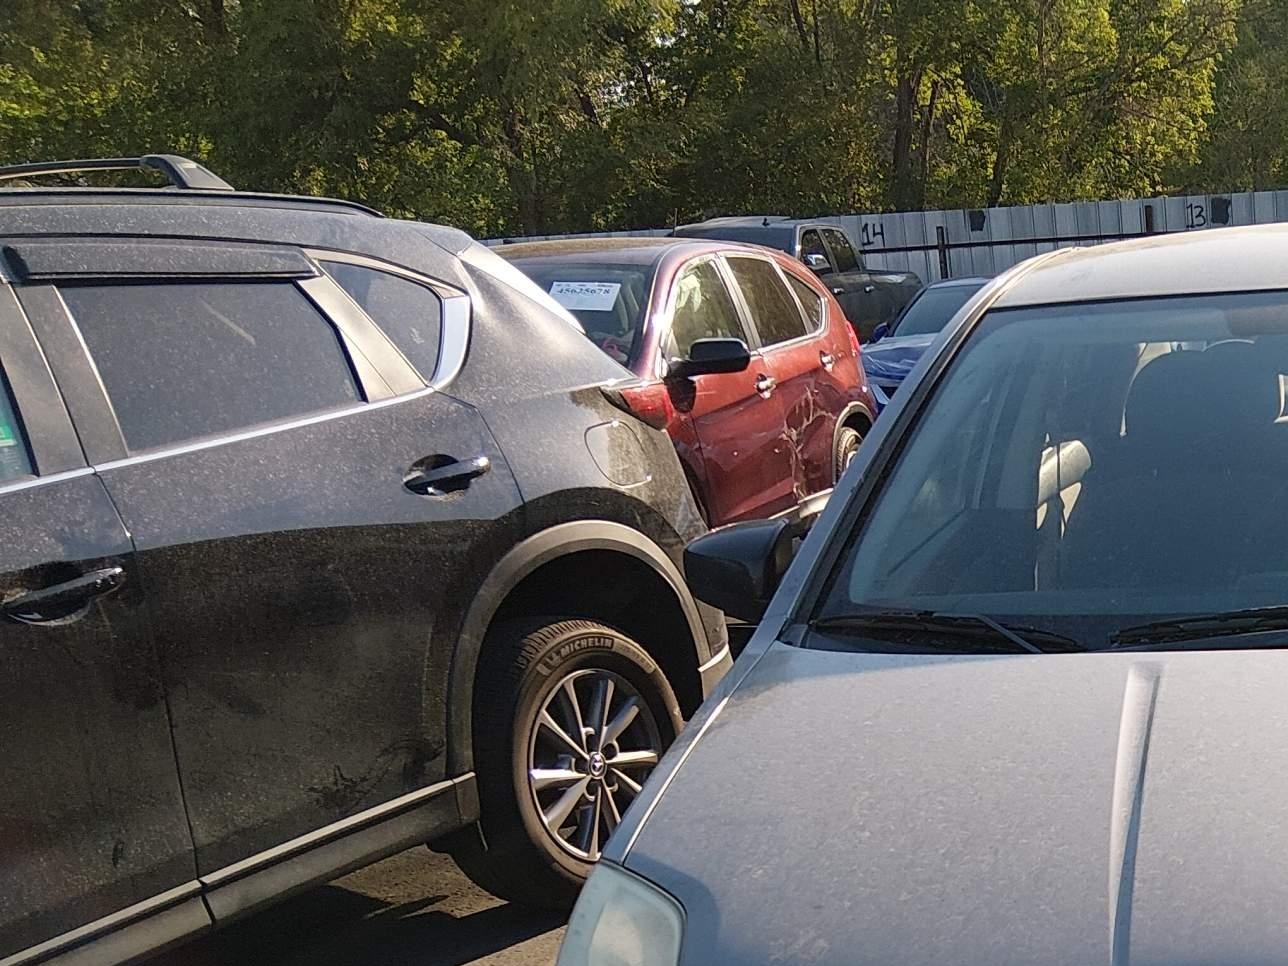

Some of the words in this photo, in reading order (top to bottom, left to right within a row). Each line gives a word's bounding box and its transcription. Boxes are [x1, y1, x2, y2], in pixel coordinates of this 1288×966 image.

[1186, 203, 1206, 228] 13
[861, 222, 885, 248] 14
[560, 637, 613, 657] MICHELIN
